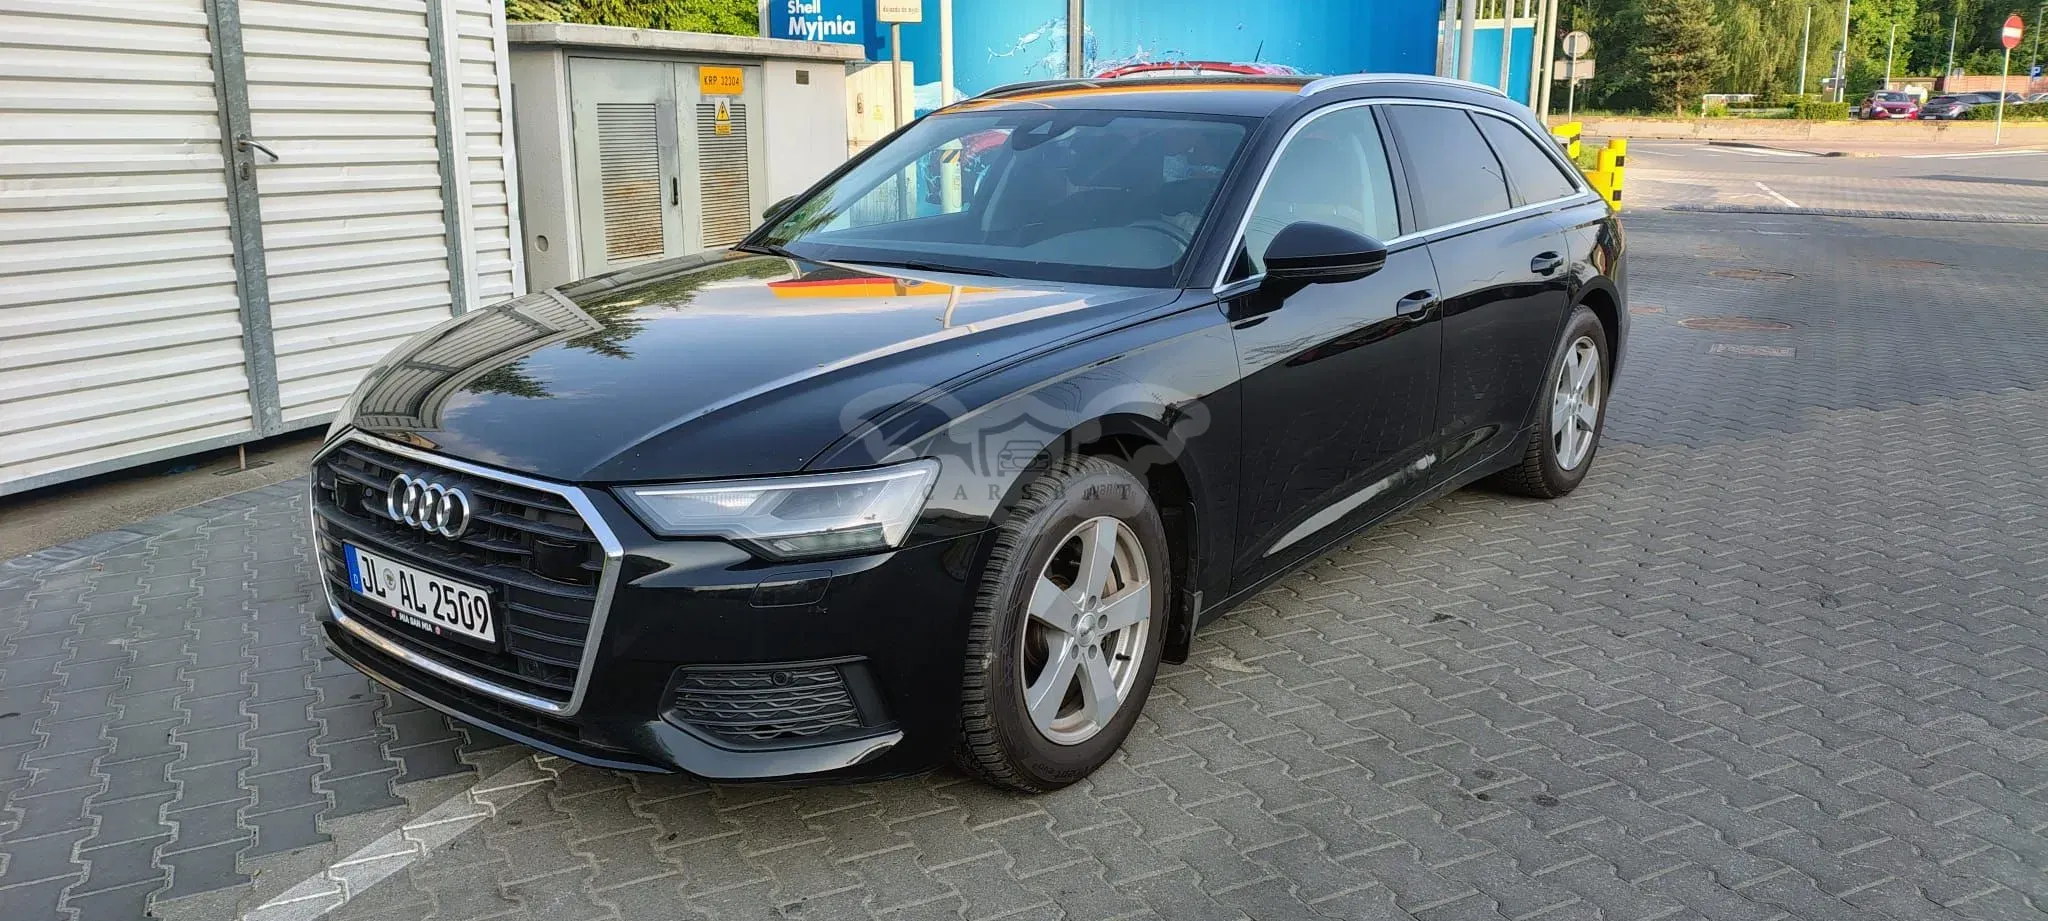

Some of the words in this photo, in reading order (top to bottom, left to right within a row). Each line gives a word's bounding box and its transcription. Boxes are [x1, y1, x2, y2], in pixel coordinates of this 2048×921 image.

[788, 0, 821, 14] Shell
[788, 15, 856, 40] Myjnia
[704, 75, 718, 86] KRP
[362, 556, 386, 598] JL
[399, 570, 427, 615] AL
[429, 581, 488, 634] 2509
